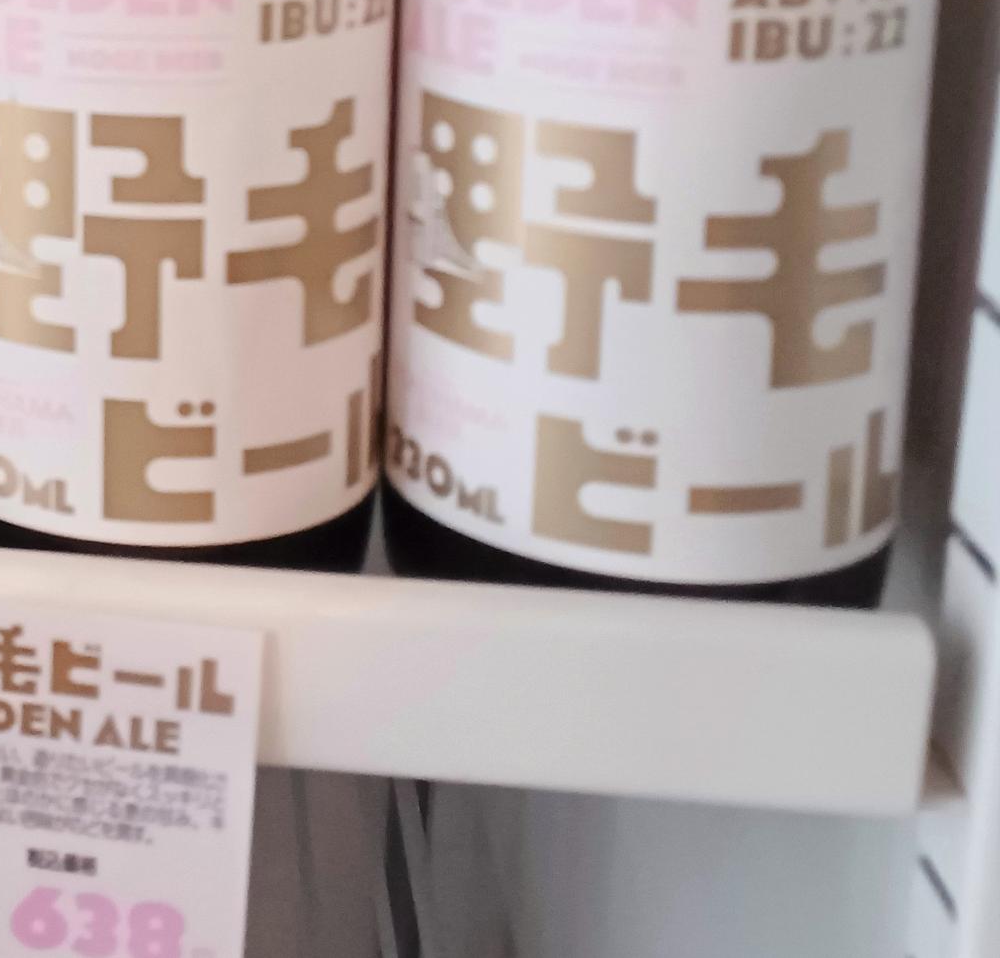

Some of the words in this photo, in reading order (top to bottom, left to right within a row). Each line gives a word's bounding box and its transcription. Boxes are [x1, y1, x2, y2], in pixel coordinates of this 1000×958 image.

[413, 88, 888, 391] 野毛
[531, 407, 898, 557] ビール
[92, 717, 181, 756] ALE
